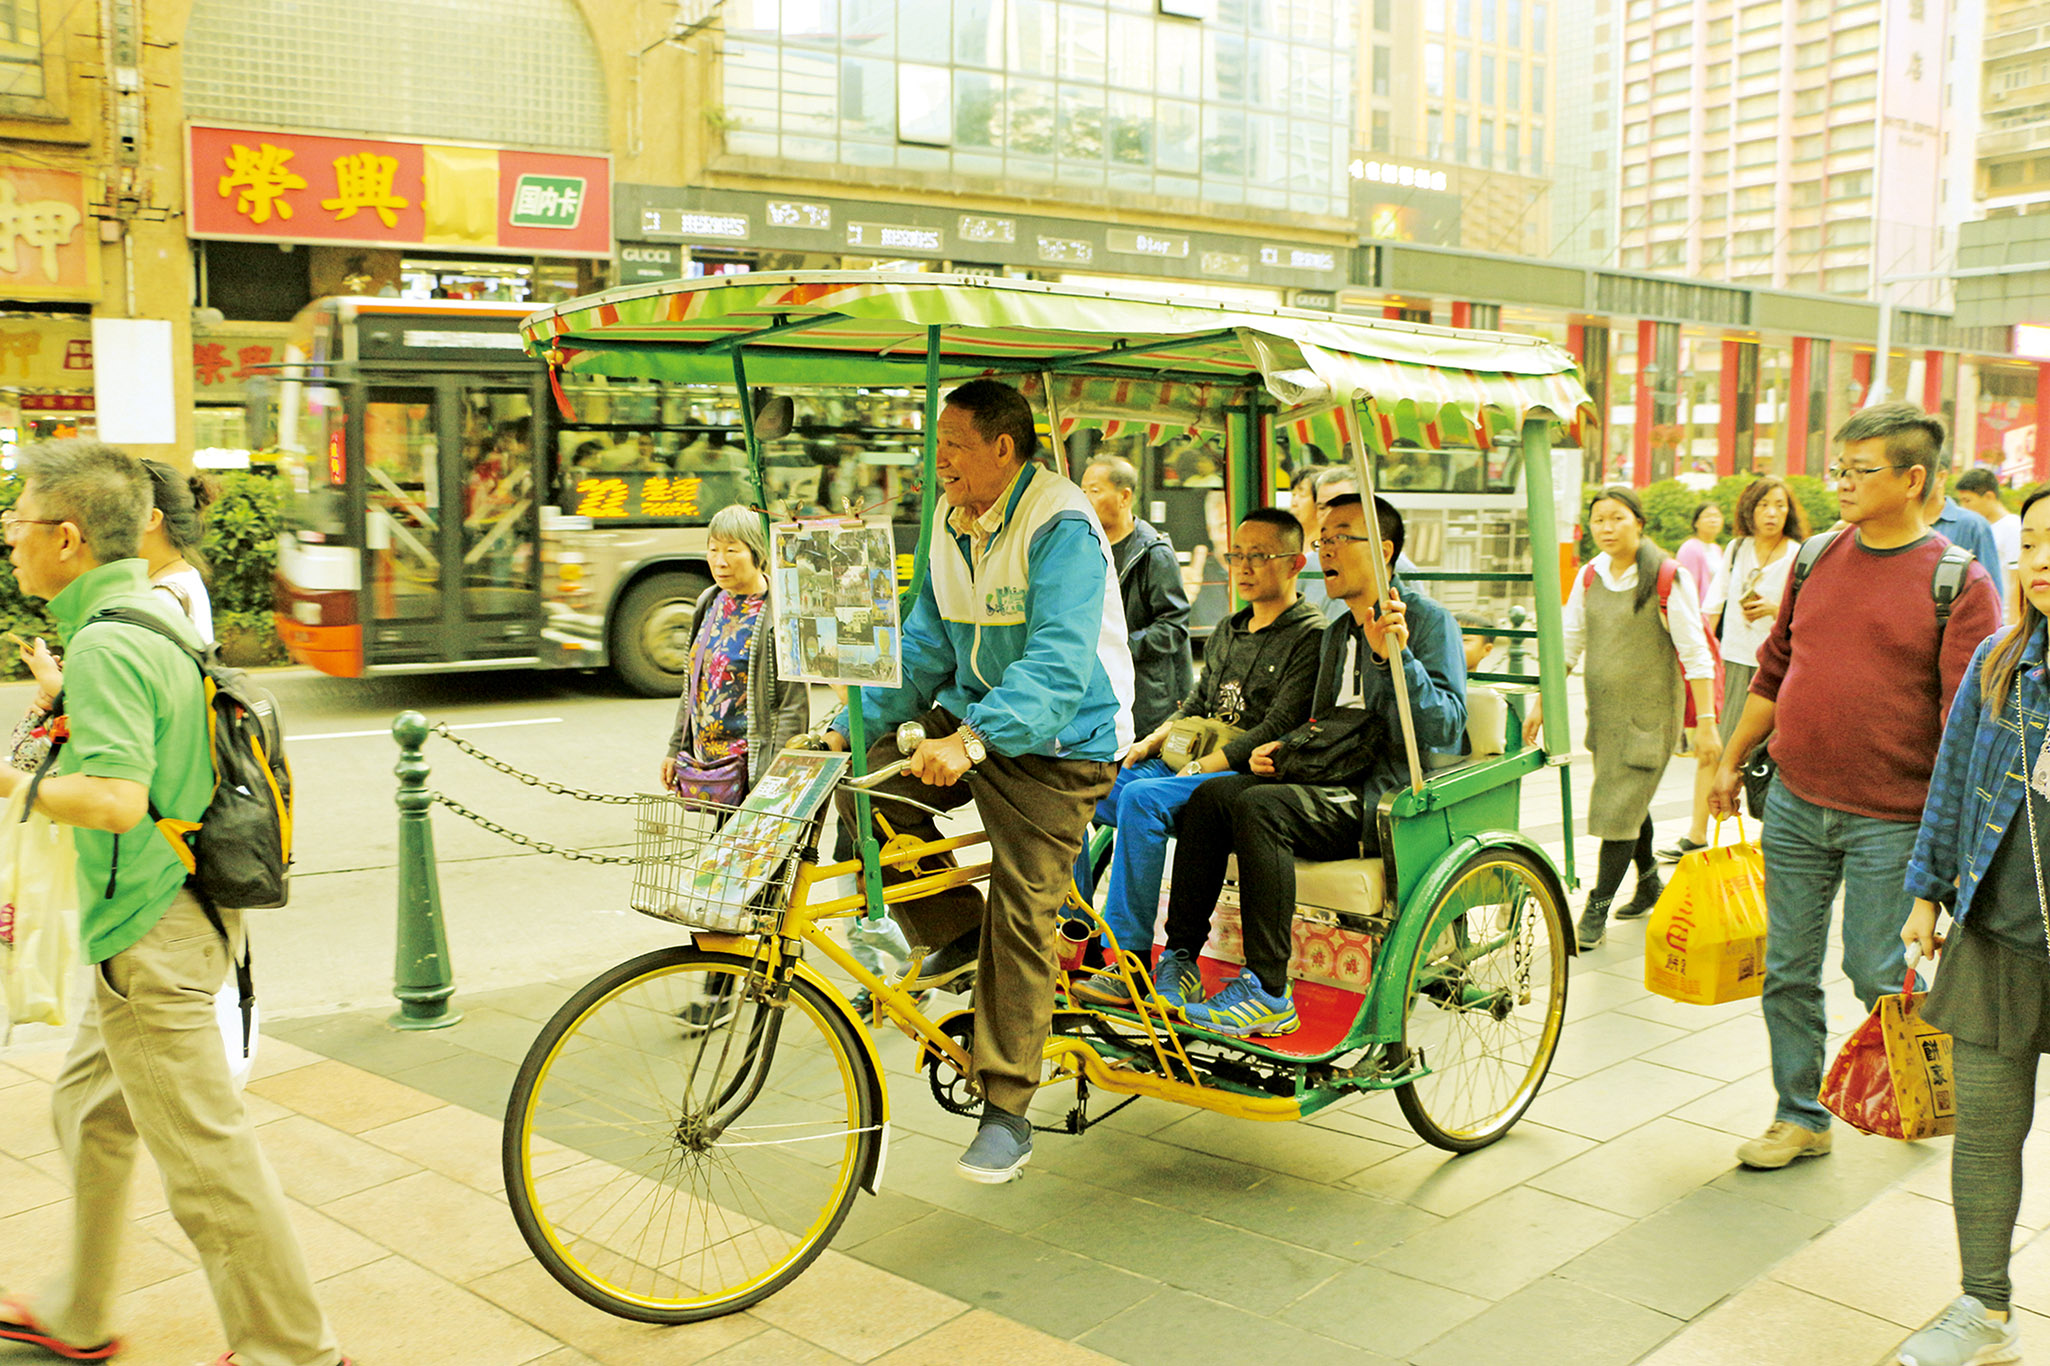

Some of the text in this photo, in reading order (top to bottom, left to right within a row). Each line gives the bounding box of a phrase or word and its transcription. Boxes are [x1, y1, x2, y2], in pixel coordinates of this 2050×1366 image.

[218, 142, 409, 229] 榮興
[515, 185, 579, 218] 国内卡
[622, 247, 672, 264] GUCCI
